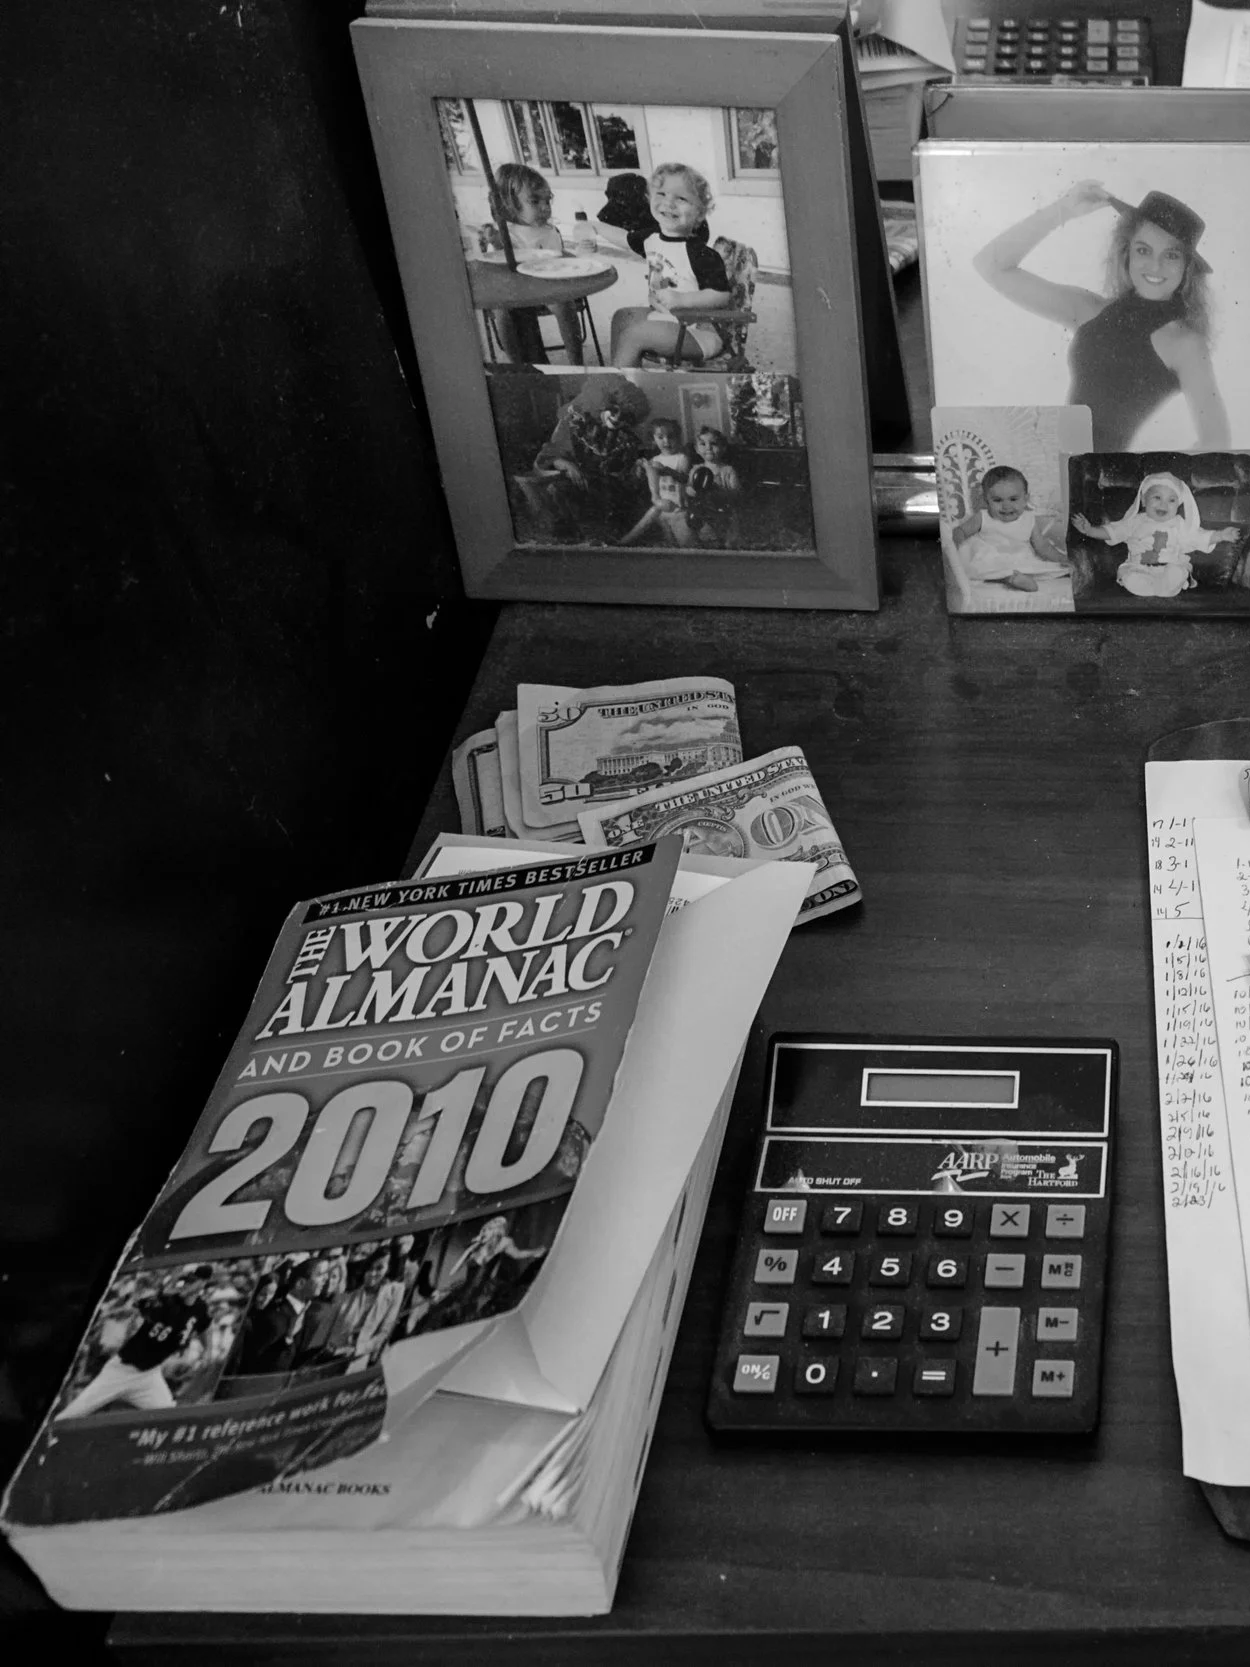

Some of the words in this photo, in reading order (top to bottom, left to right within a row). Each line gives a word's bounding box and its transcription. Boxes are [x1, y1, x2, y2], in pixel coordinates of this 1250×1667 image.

[707, 702, 729, 711] GOD
[655, 791, 695, 813] THE
[699, 769, 767, 803] UNITED
[781, 785, 801, 798] GOD
[349, 892, 392, 912] NEW
[399, 883, 450, 903] YORK
[458, 874, 517, 896] TIMES
[525, 850, 645, 885] BESTSELLER
[288, 925, 336, 984] THE
[340, 880, 636, 972] WORLD
[255, 931, 625, 1041] ALMANAC
[237, 1048, 312, 1081] AND
[325, 1034, 425, 1069] BOOK
[440, 1028, 486, 1054] OF
[497, 1001, 604, 1044] FACTS
[168, 1048, 585, 1240] 2010
[937, 1151, 1000, 1172] AARP
[1002, 1153, 1057, 1163] Automobile
[815, 1177, 841, 1186] SHUT
[842, 1177, 863, 1186] OFF
[1027, 1177, 1079, 1188] HARTFORD
[1036, 1170, 1056, 1180] THE
[772, 1206, 798, 1223] OFF
[833, 1207, 852, 1225] 7
[887, 1207, 908, 1227] 8
[943, 1209, 964, 1228] 9
[822, 1256, 843, 1276] 4
[880, 1257, 901, 1276] 5
[936, 1259, 958, 1278] 6
[817, 1309, 831, 1330] 1
[871, 1311, 894, 1331] 2
[929, 1312, 951, 1332] 3
[804, 1363, 827, 1385] 0
[201, 1411, 286, 1442] reference
[288, 1397, 331, 1420] work
[332, 1390, 360, 1409] for
[336, 1482, 392, 1496] BOOKS
